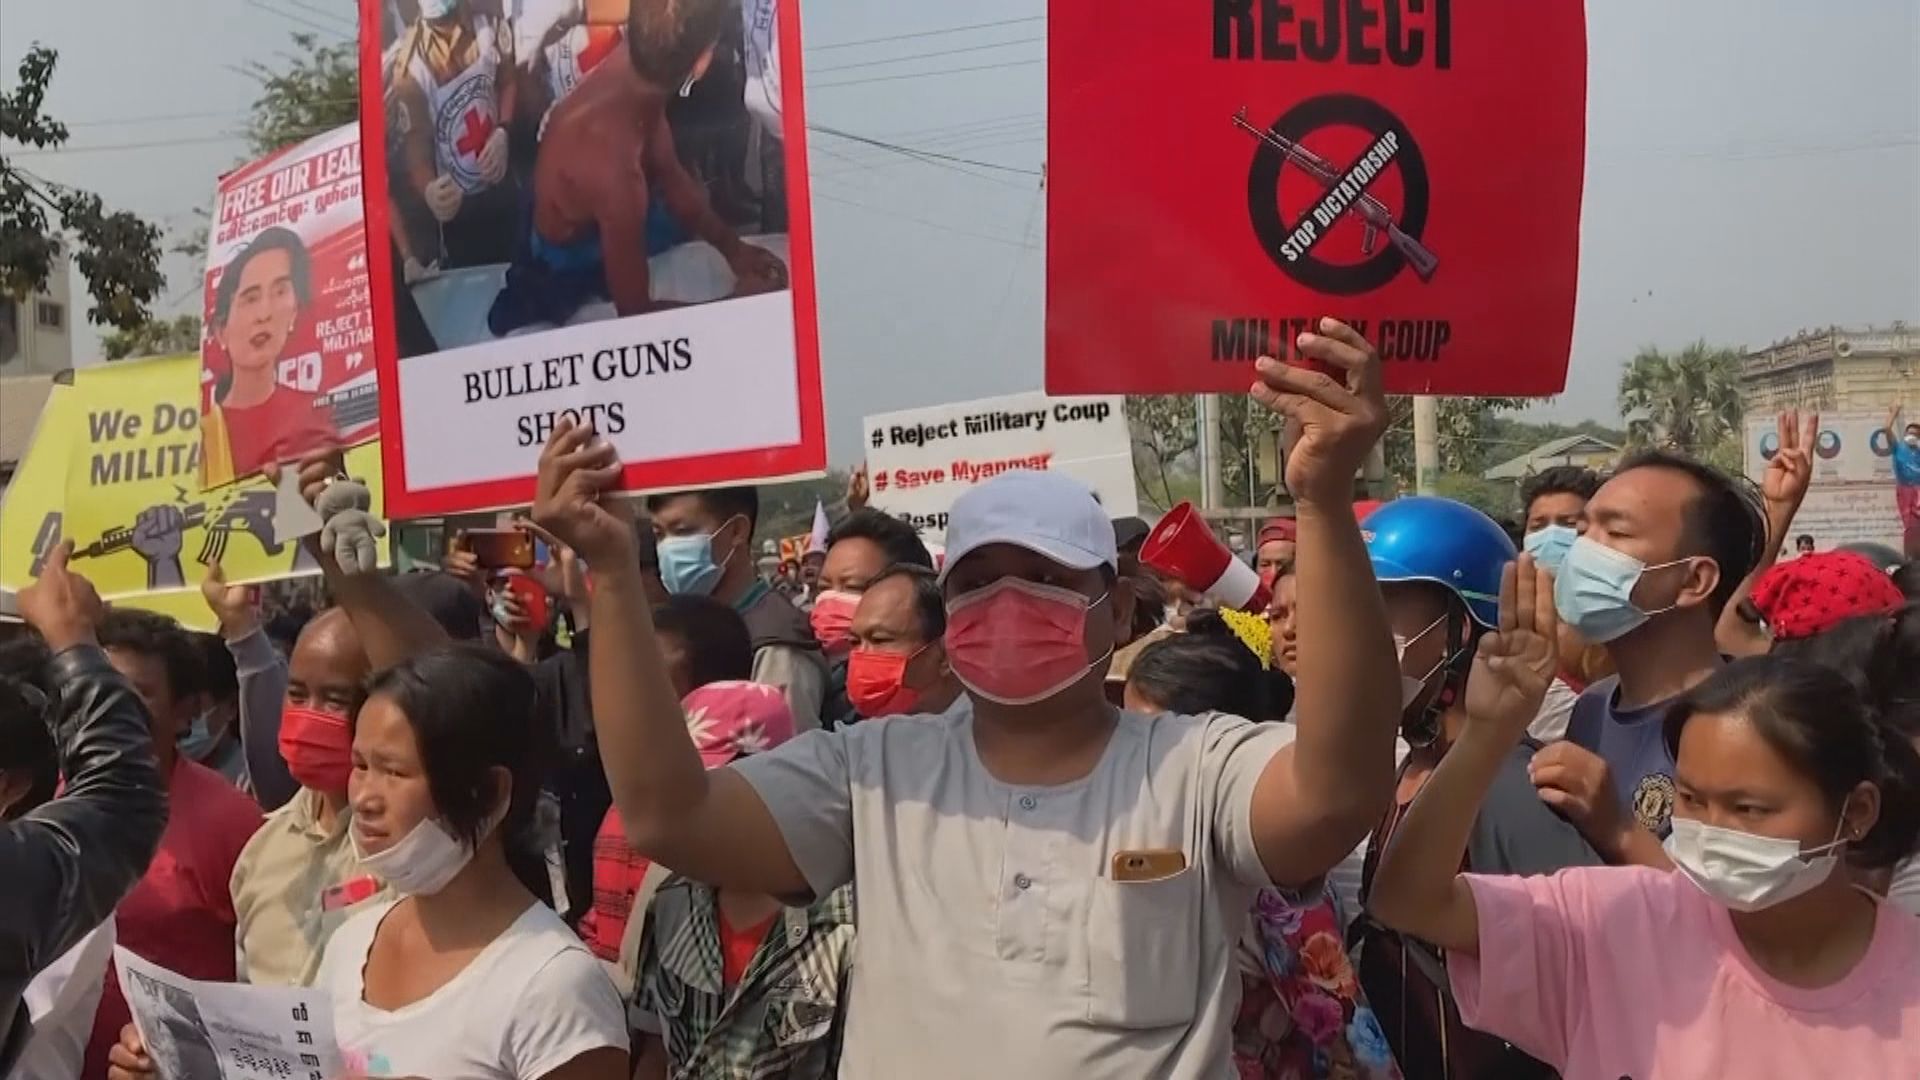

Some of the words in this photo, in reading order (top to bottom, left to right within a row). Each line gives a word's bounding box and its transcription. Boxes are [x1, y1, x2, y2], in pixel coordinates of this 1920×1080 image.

[1213, 0, 1452, 70] REJECT
[223, 178, 267, 222] FREE
[271, 160, 311, 200] OUR
[1280, 220, 1317, 262] STOP
[1312, 130, 1400, 228] DICTATORSHIP
[316, 312, 361, 339] REJECT
[1212, 317, 1367, 362] MILIT
[1378, 319, 1451, 362] COUP
[464, 353, 584, 403] BULLET
[592, 337, 692, 382] GUNS
[88, 408, 141, 443] We
[890, 420, 959, 448] Reject
[965, 409, 1047, 437] Military
[1054, 401, 1111, 423] Coup
[90, 441, 200, 486] MILITA
[895, 467, 945, 489] Save
[952, 452, 1052, 483] Myanmar
